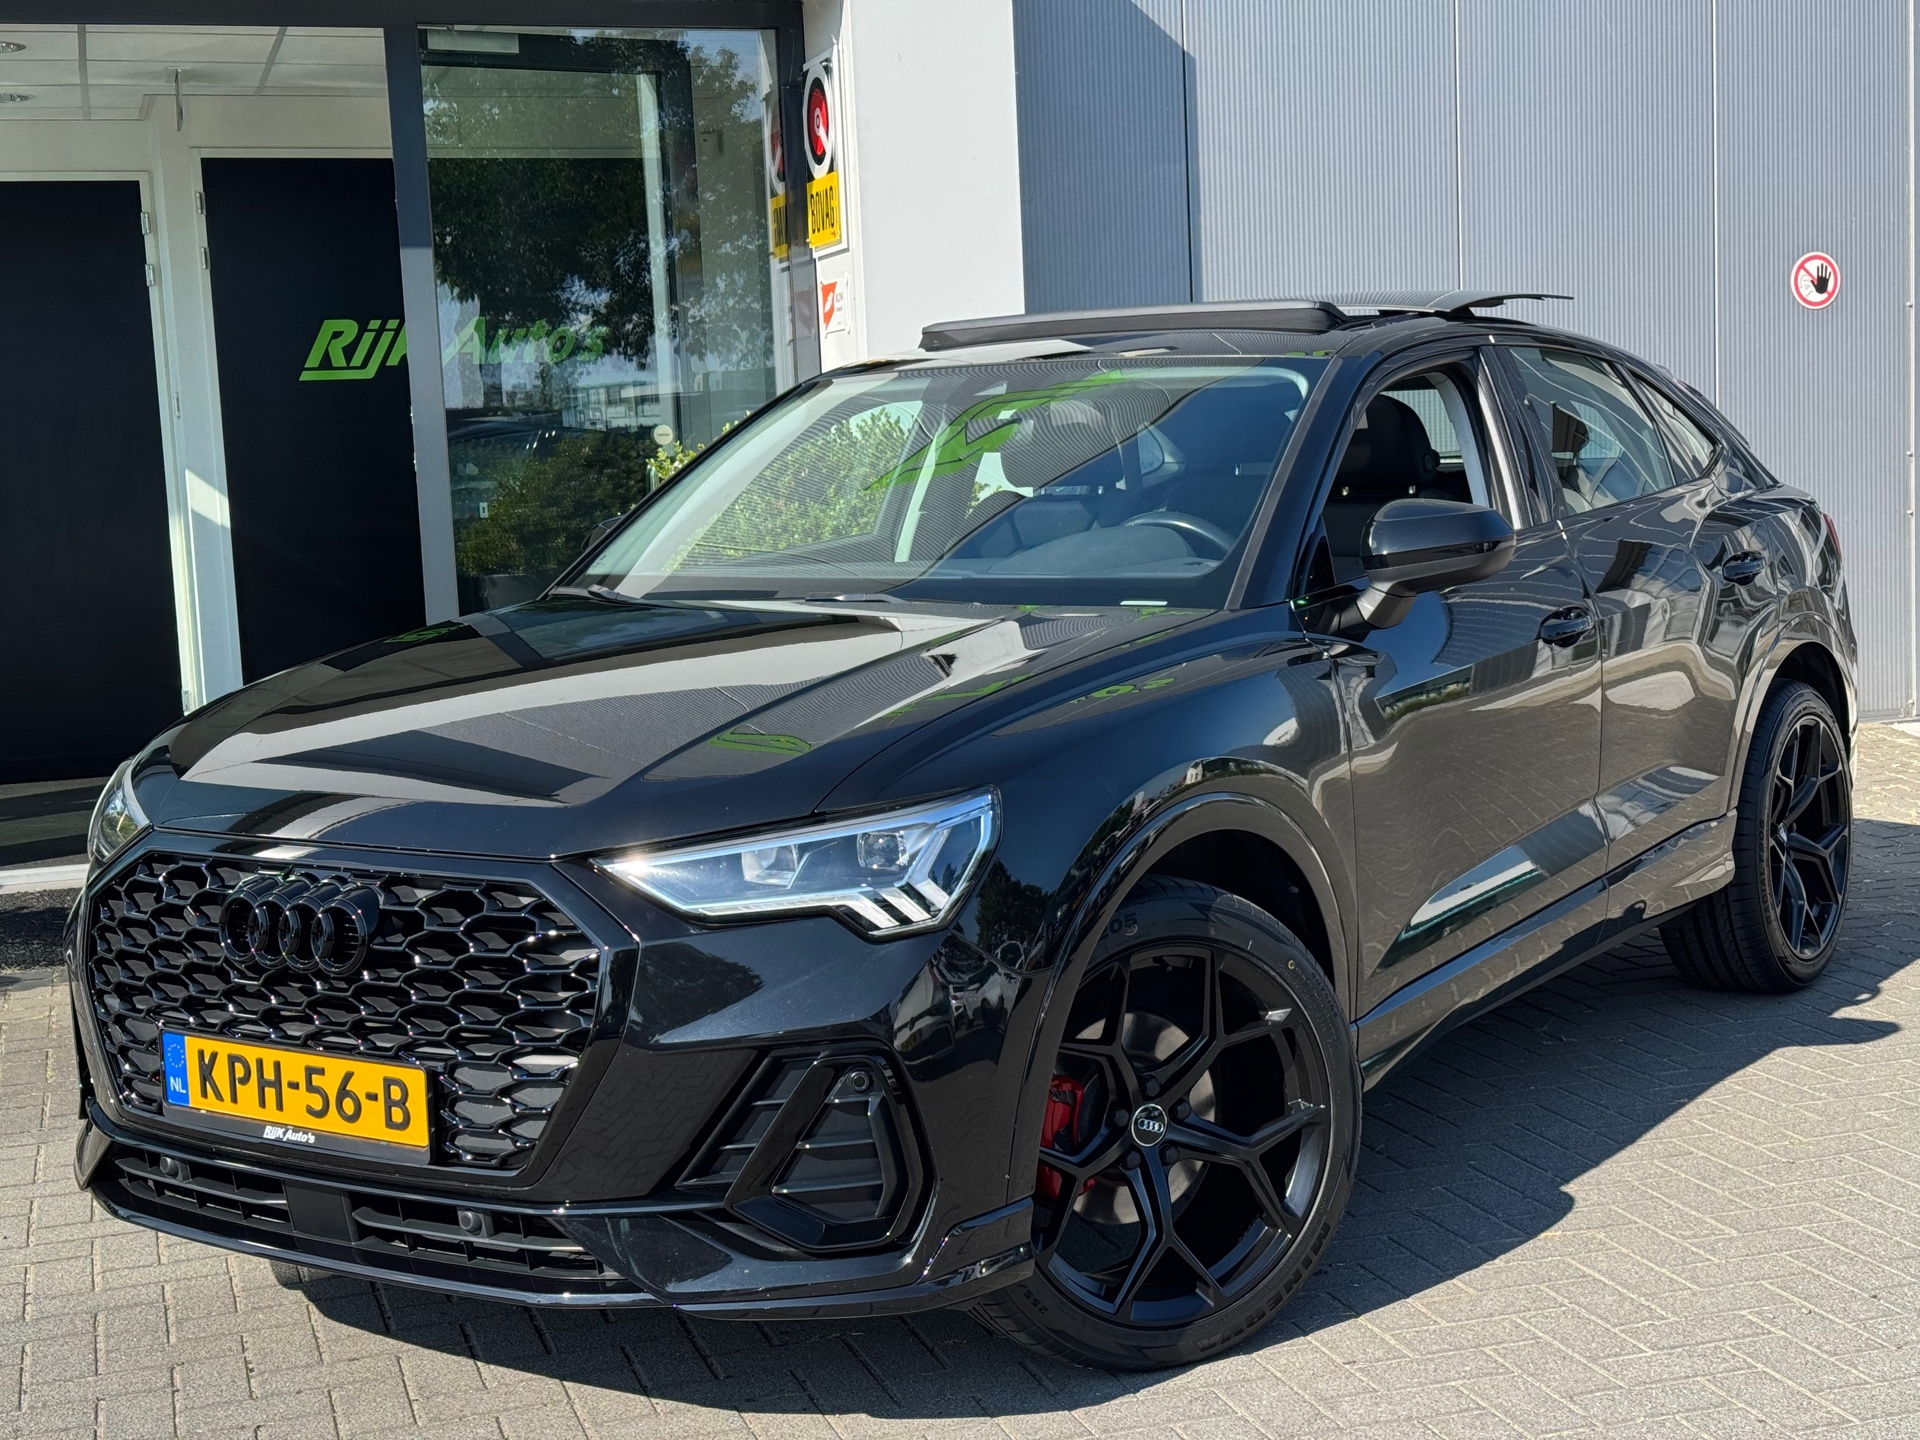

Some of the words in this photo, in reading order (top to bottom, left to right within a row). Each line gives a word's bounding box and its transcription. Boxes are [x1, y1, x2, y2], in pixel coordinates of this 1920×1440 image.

[810, 186, 835, 234] BOVAG
[170, 1076, 186, 1094] NL
[197, 1048, 411, 1131] KPH-56-B
[284, 1127, 315, 1143] Auto's
